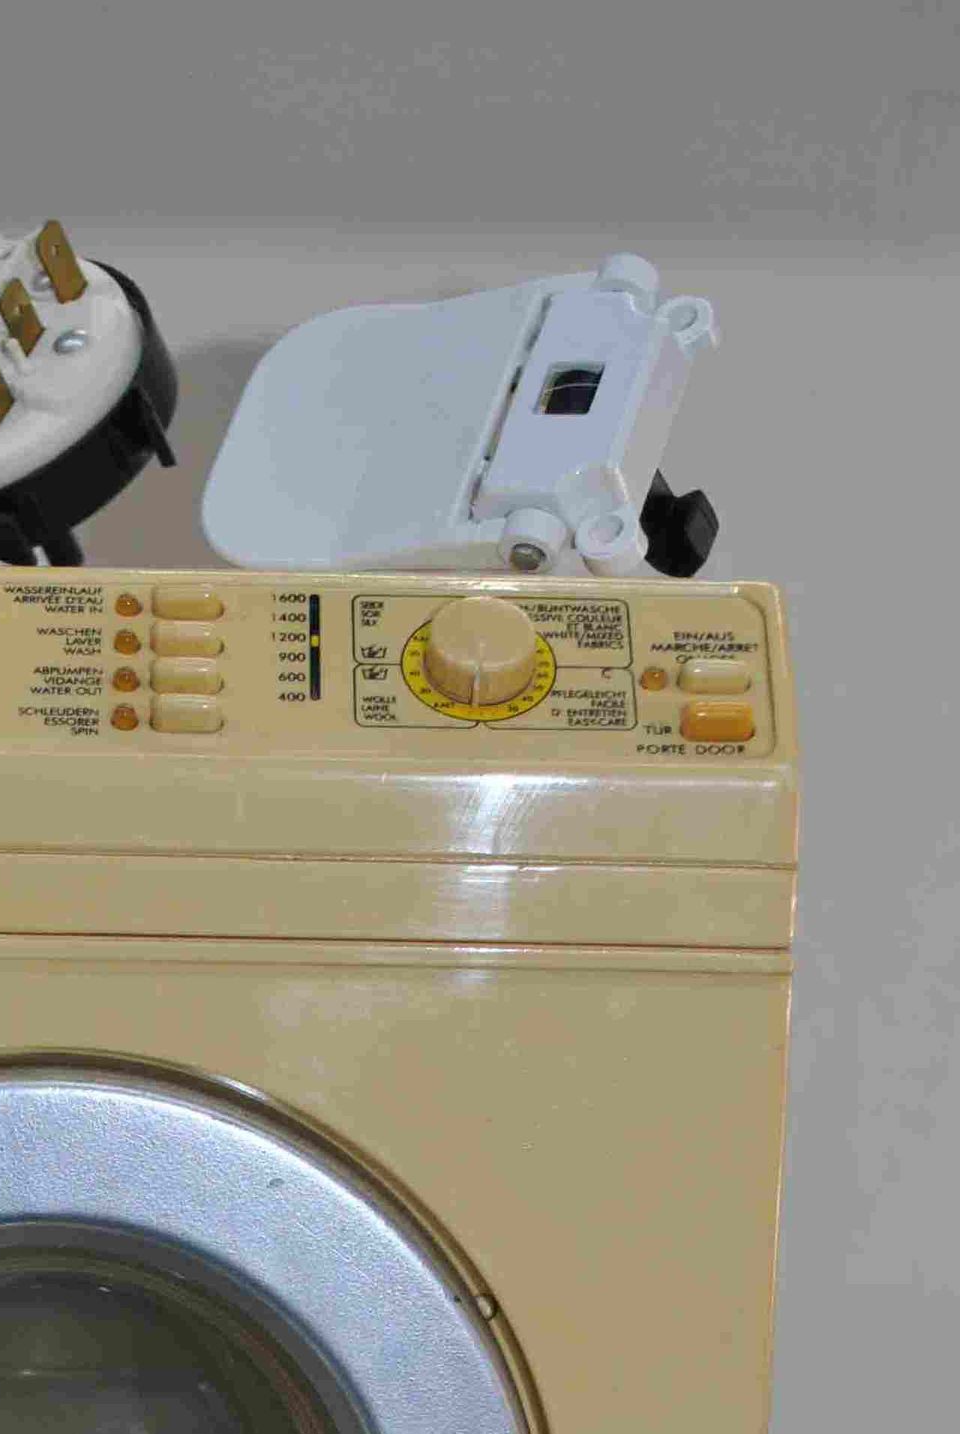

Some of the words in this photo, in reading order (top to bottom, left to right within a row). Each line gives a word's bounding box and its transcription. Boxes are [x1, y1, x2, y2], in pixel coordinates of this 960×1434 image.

[4, 586, 103, 596] WASSEREINLAUF
[272, 594, 306, 604] 1600
[44, 605, 85, 613] WATER
[89, 605, 103, 613] IN
[272, 613, 306, 623] 1400
[566, 614, 622, 623] COULEUR
[37, 628, 103, 637] WASCHEN
[583, 623, 622, 632] BLANC
[66, 637, 102, 646] LAVER
[271, 633, 306, 643] 1200
[673, 631, 735, 642] EIN/AUS
[577, 640, 624, 649] FABRICS
[63, 647, 102, 656] WASH
[278, 652, 306, 662] 900
[33, 666, 103, 676] ABPUMPEN
[43, 677, 102, 686] VIDANGE
[278, 672, 306, 682] 600
[30, 686, 71, 695] WATER
[76, 686, 103, 695] OUT
[278, 692, 306, 702] 400
[17, 707, 99, 717] SCHLEUDERN
[43, 717, 99, 727] ESSORER
[71, 727, 99, 736] SPIN
[636, 744, 686, 755] PORTE
[695, 744, 745, 755] DOOR
